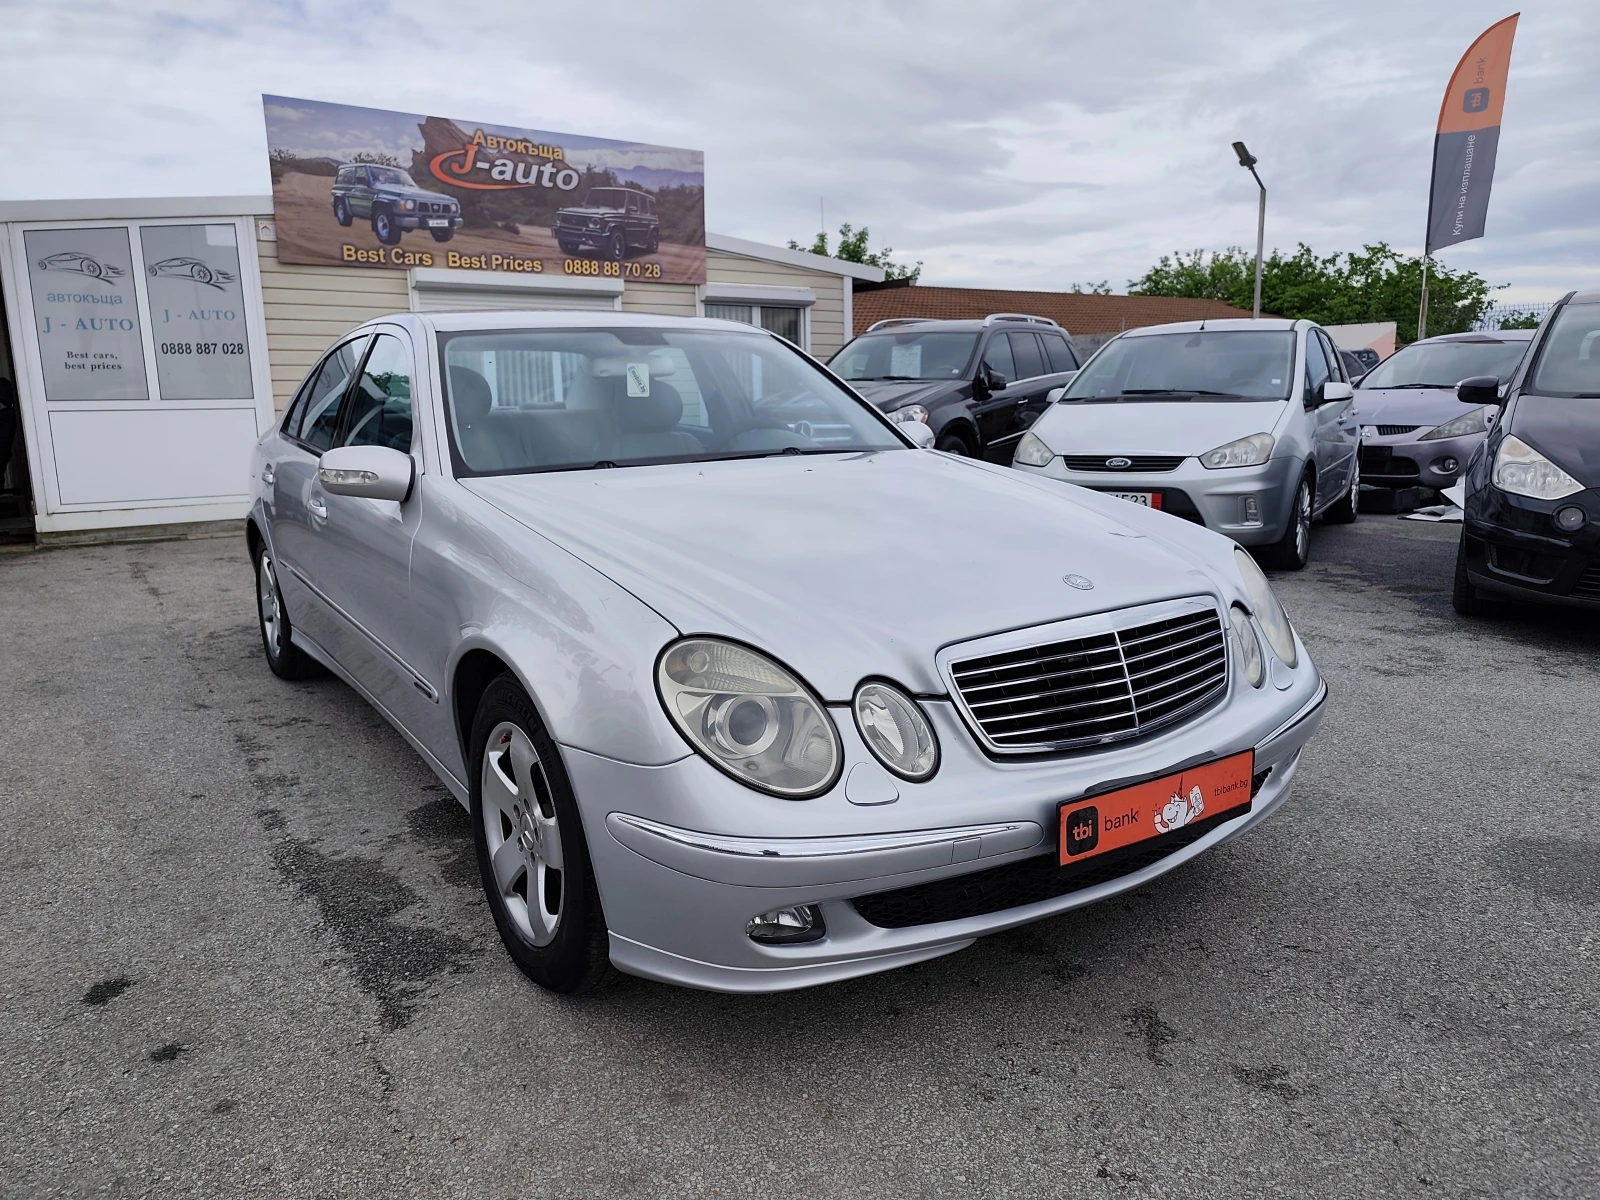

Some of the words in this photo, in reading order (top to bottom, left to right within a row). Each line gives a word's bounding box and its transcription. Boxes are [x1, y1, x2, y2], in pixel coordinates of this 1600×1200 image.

[1473, 56, 1487, 84] bank
[1471, 92, 1482, 109] tbi
[473, 130, 563, 160] Автокъща
[451, 144, 580, 191] J-auto
[1460, 134, 1476, 194] изплащане
[1458, 196, 1467, 209] на
[1452, 210, 1464, 236] Купи
[342, 245, 386, 263] Best
[391, 248, 433, 266] Cars
[448, 252, 488, 269] Best
[491, 254, 542, 272] Prices
[564, 259, 600, 275] 0888
[603, 261, 620, 276] 88
[624, 263, 641, 277] 70
[644, 264, 661, 278] 28
[47, 292, 122, 305] автокъща
[188, 310, 236, 321] AUTO
[75, 318, 134, 332] AUTO
[66, 351, 89, 359] Best
[161, 343, 192, 355] 0888
[196, 343, 217, 355] 887
[222, 343, 244, 355] 028
[64, 362, 87, 370] best
[90, 362, 122, 371] prices
[1072, 819, 1093, 842] tbi
[1104, 807, 1139, 832] bank
[1214, 778, 1248, 797] tbibank.bg
